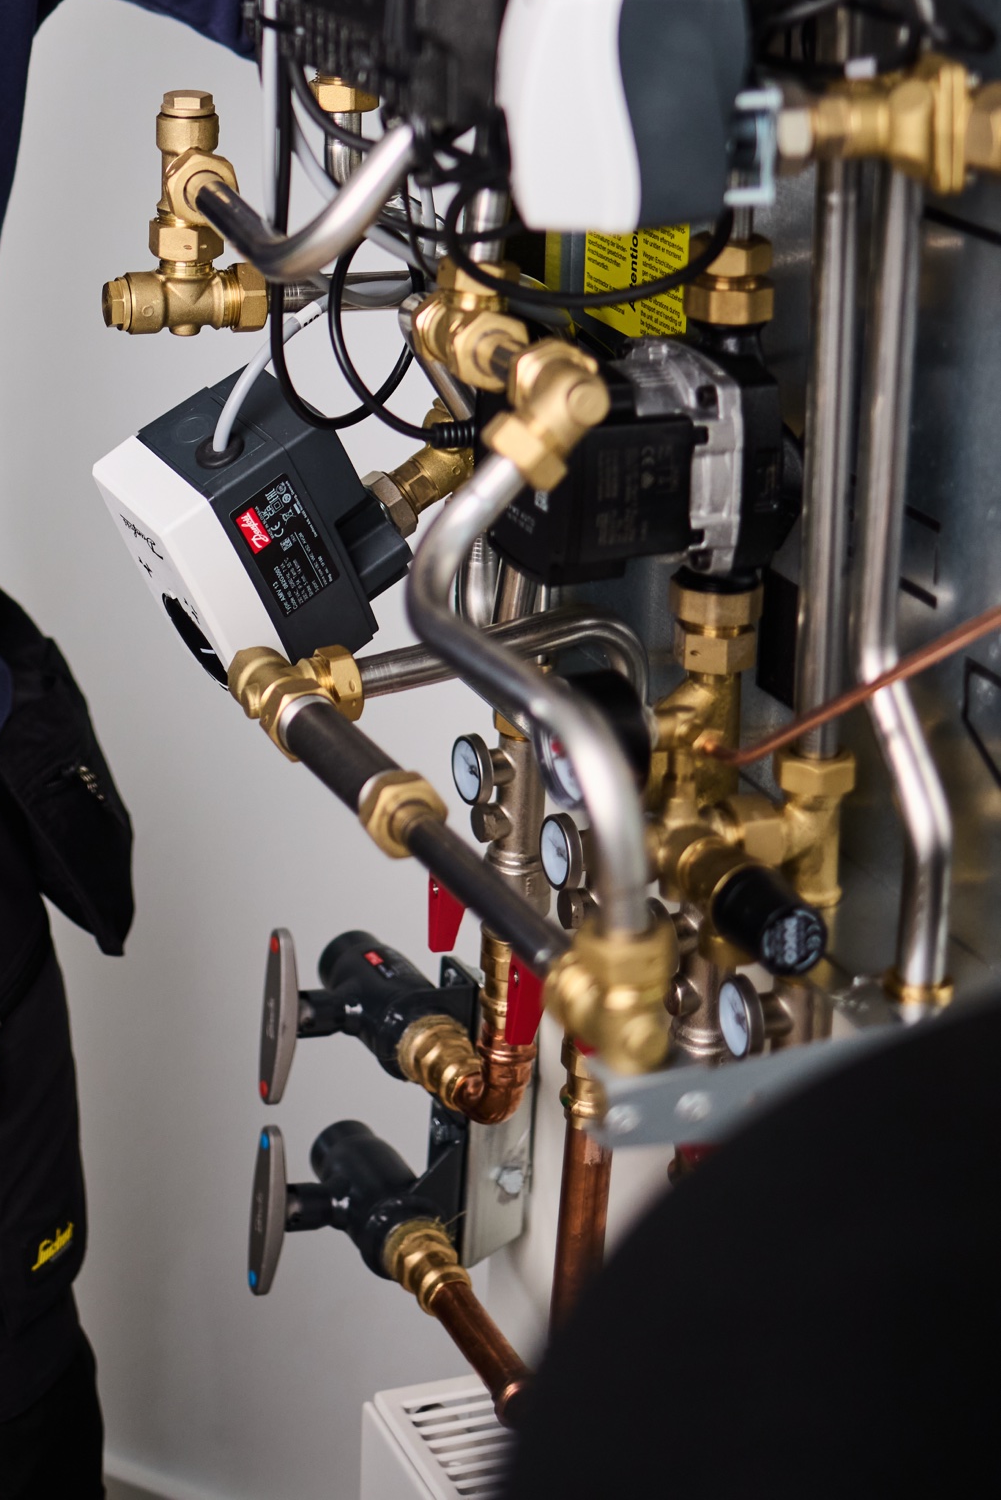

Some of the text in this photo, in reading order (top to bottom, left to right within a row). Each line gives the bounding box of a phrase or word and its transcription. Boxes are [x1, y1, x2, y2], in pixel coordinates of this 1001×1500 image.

[272, 581, 279, 589] 13
[275, 589, 286, 602] AMV
[290, 597, 298, 610] Code
